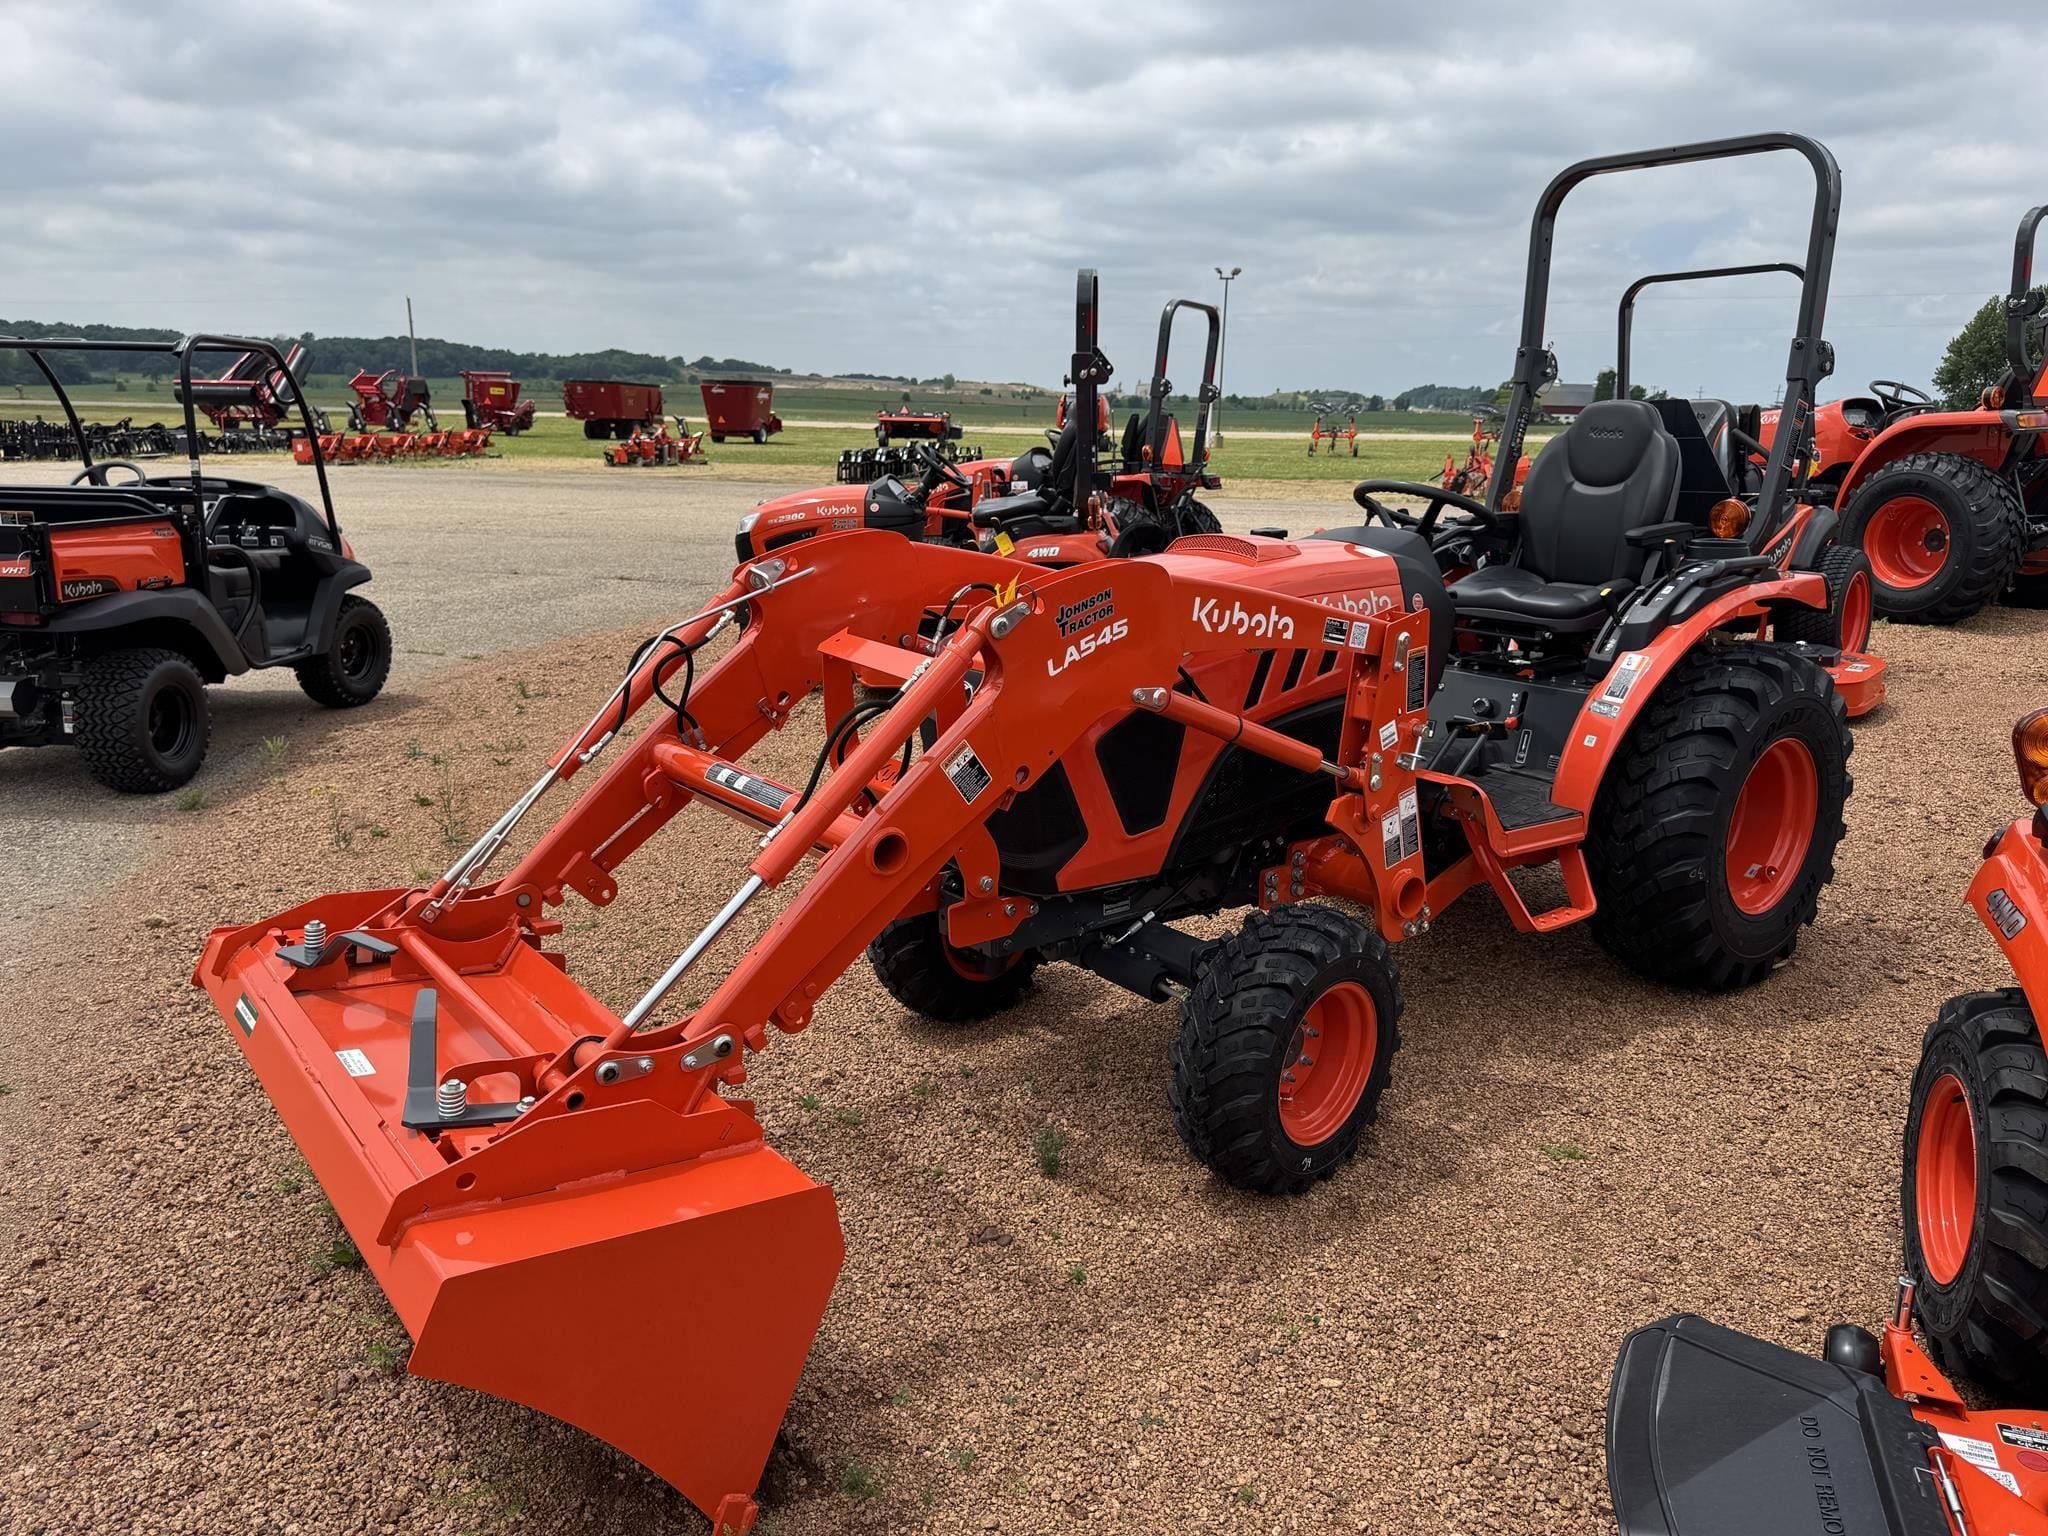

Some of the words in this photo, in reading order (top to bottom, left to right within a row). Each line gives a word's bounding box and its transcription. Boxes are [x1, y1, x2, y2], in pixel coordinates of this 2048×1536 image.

[816, 503, 857, 516] Kubota
[1027, 546, 1060, 558] 4WD
[1768, 537, 1792, 563] ubota
[1, 566, 26, 575] VHT
[64, 580, 103, 598] Kubota
[1312, 590, 1393, 617] bota
[1055, 587, 1113, 625] JOHNSON
[1192, 596, 1294, 640] Kubota
[1058, 604, 1115, 639] TRACTOR
[1047, 617, 1129, 677] LA545
[1986, 887, 2028, 942] 4WD
[1799, 1415, 1822, 1439] DO
[1805, 1445, 1833, 1479] NOT
[1814, 1482, 1847, 1536] REMO
